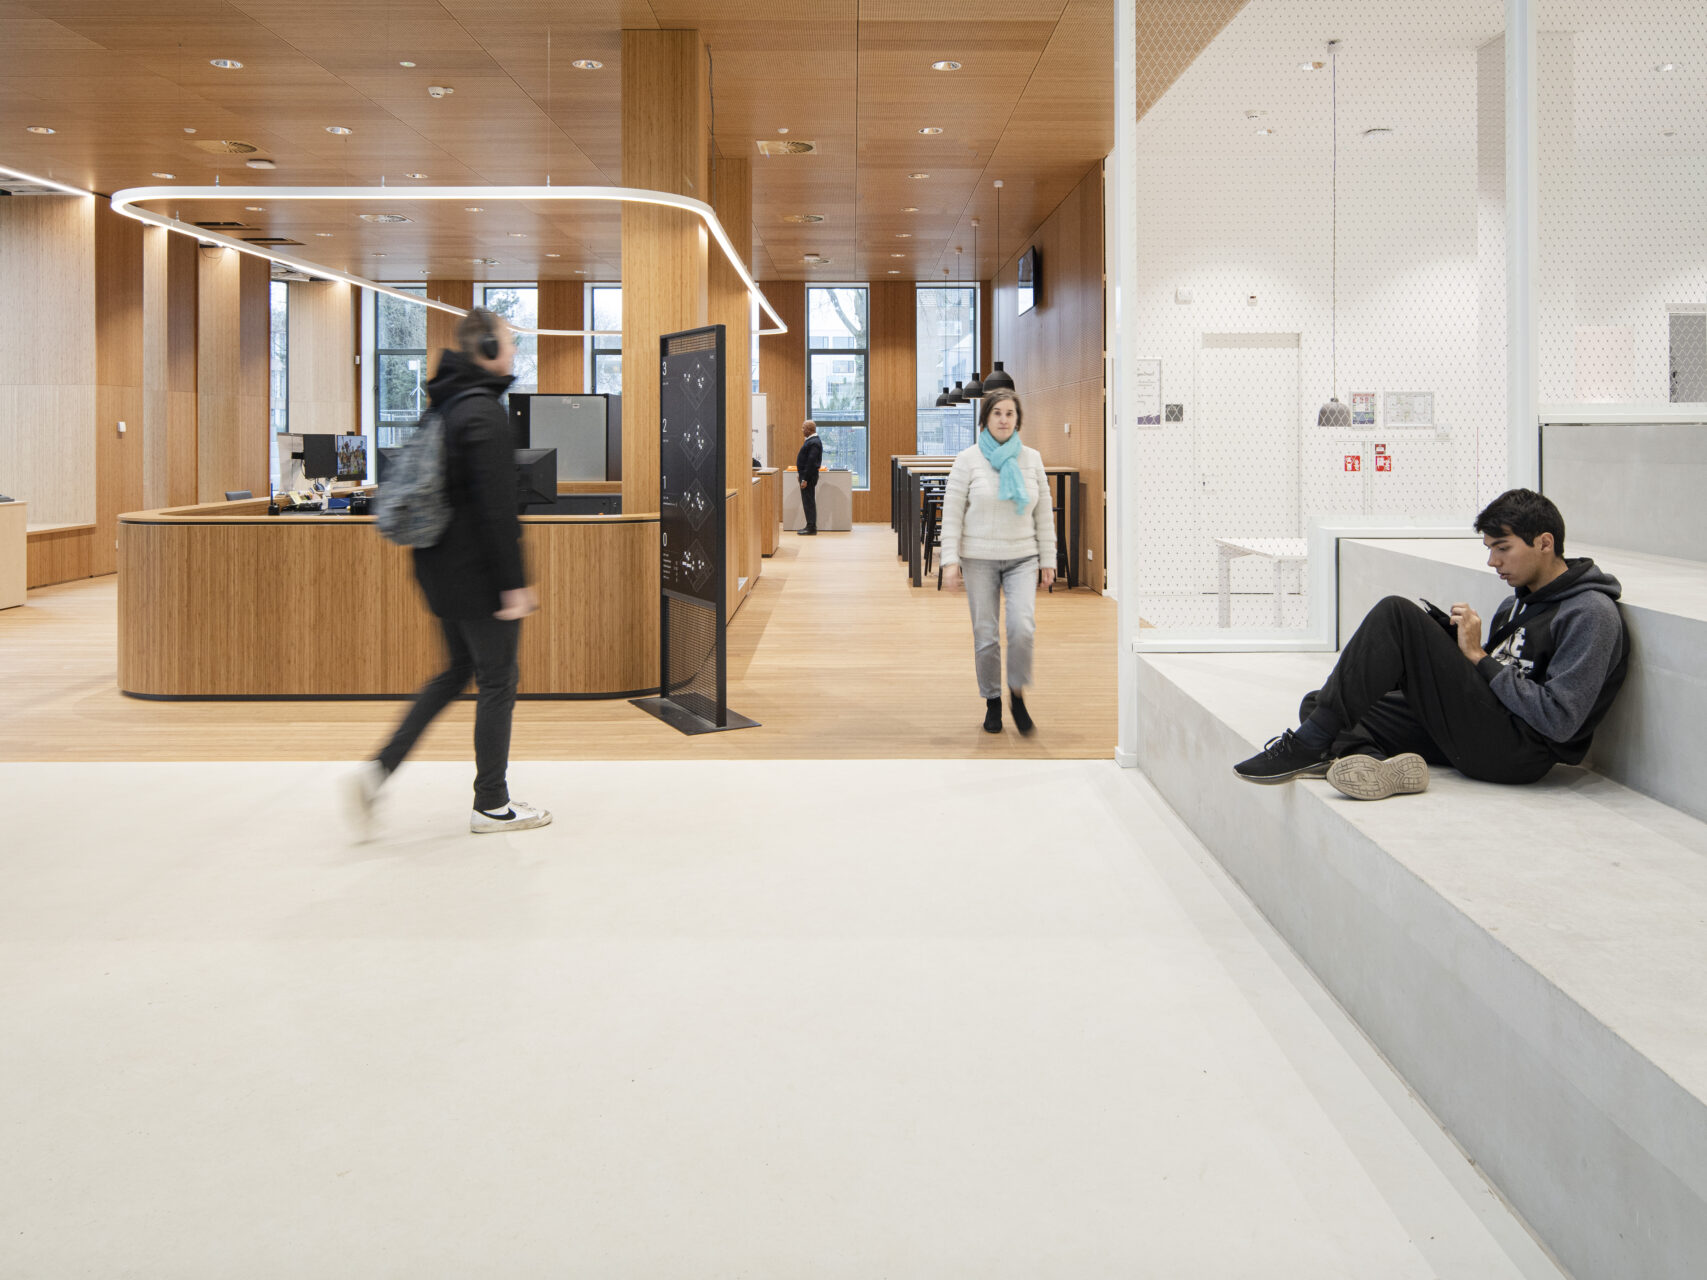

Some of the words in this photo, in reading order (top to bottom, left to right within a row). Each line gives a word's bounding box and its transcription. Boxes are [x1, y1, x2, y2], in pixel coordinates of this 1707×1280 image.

[662, 361, 667, 376] 3
[662, 418, 667, 433] 2
[662, 532, 668, 547] 0
